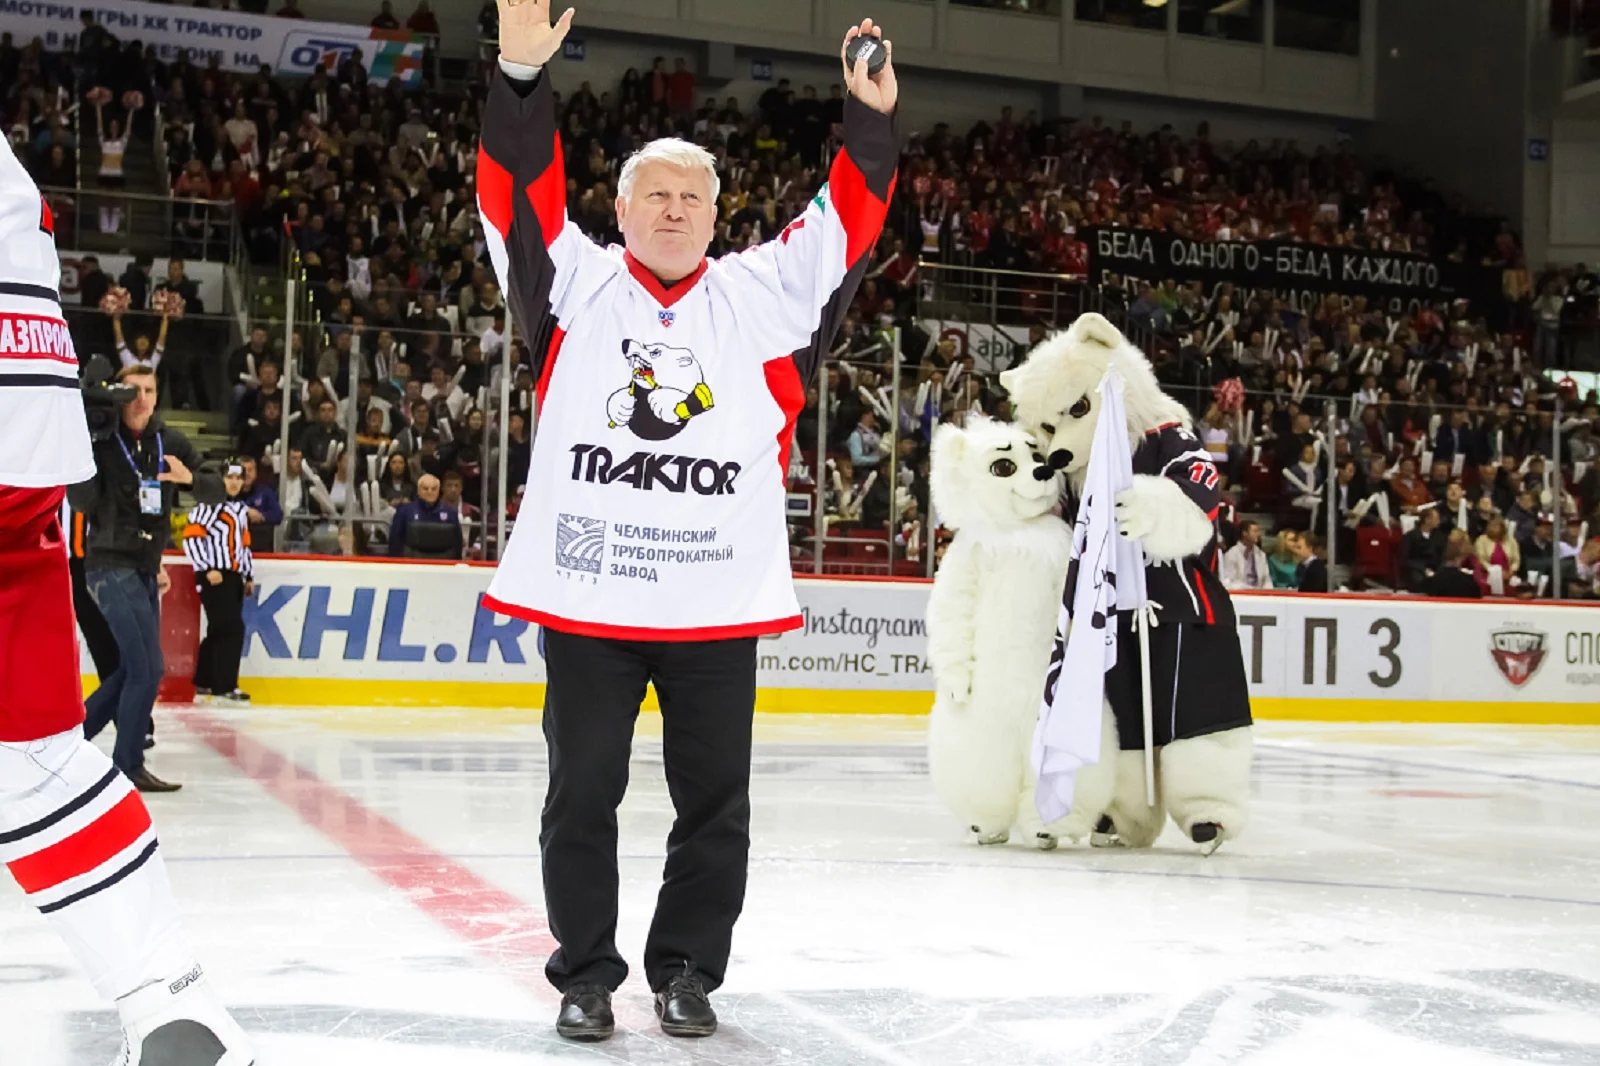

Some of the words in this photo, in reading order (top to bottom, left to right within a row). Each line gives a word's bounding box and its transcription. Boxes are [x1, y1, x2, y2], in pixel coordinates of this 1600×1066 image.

[81, 8, 138, 28] ГРЫ
[142, 16, 169, 31] ХК
[174, 18, 263, 41] ТРАКТОР
[1097, 230, 1155, 264] БЕДА
[568, 443, 741, 495] TRAKTOR
[613, 523, 718, 544] ЧЕЛЯБИНСКИЙ
[610, 544, 734, 564] ТРУБОПРОКАТНЫЙ
[609, 563, 659, 583] ЗАВОД
[756, 651, 935, 677] m.com/HC_TRA
